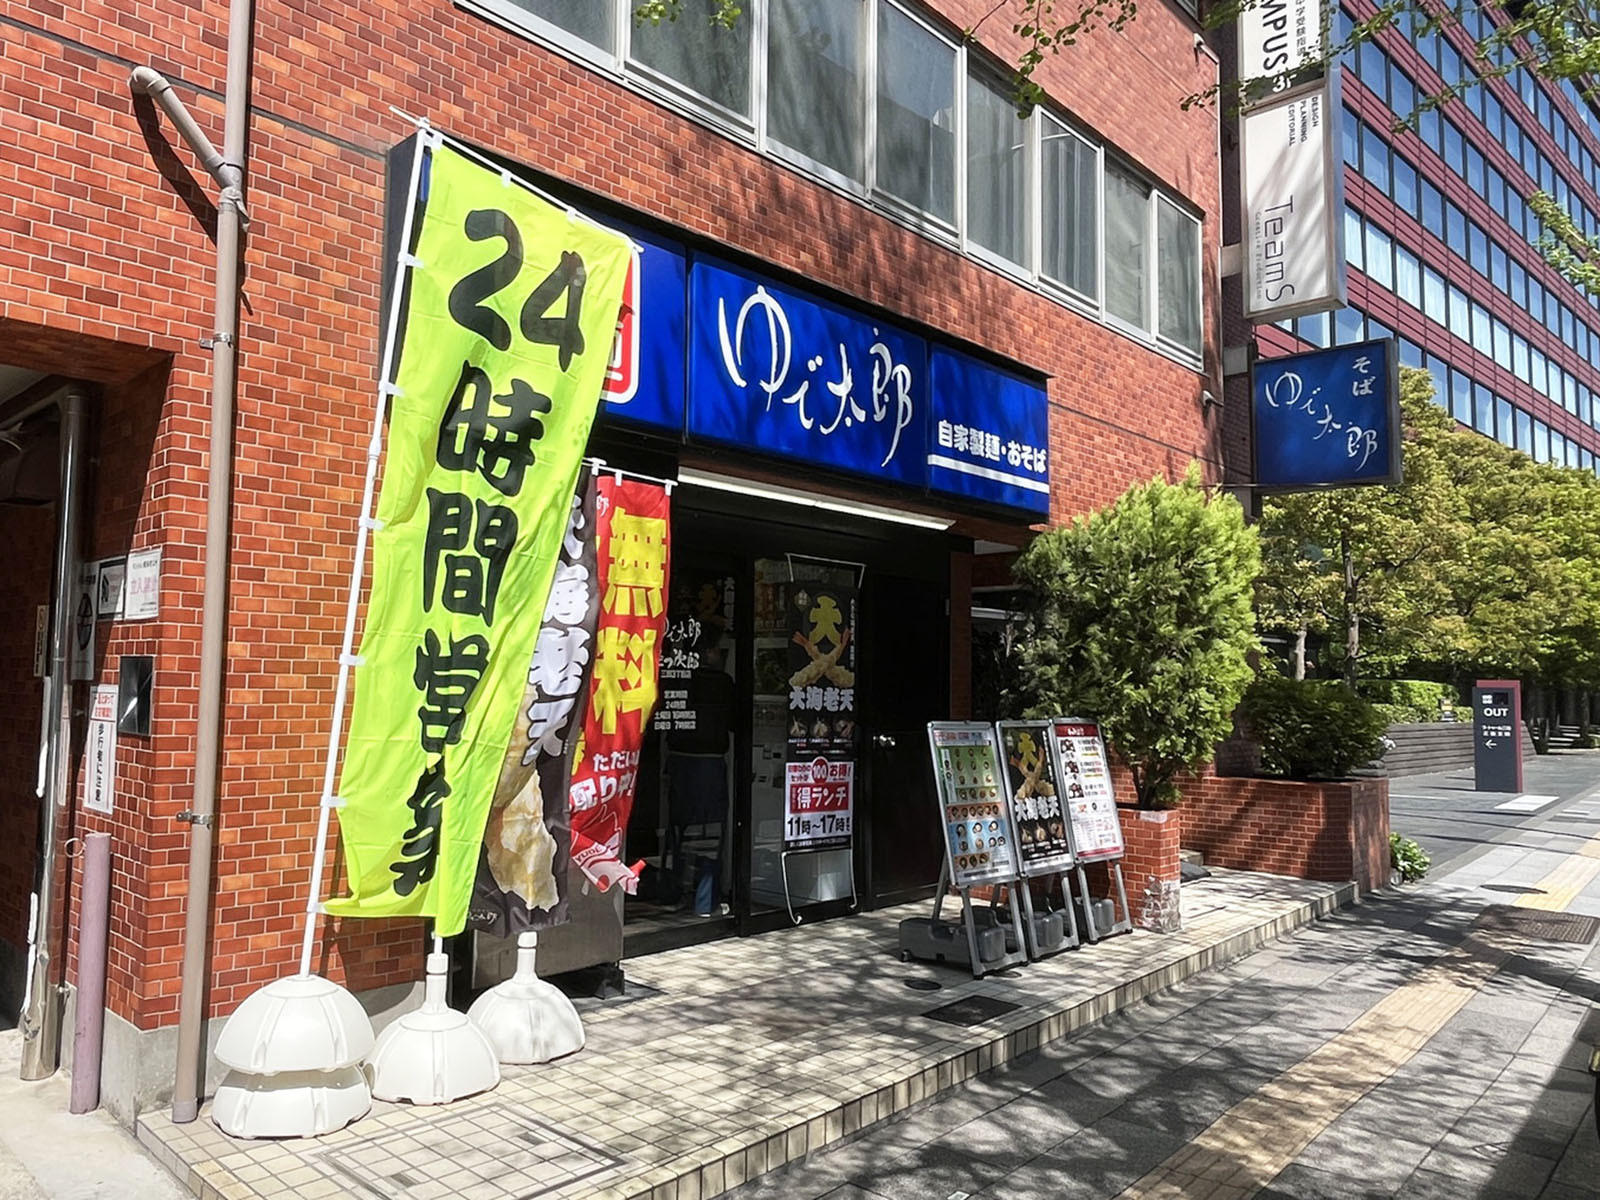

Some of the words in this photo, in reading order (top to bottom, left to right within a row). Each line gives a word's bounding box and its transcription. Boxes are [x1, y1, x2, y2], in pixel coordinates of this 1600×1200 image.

[1288, 104, 1296, 147] EDITORIAL
[1300, 100, 1308, 143] PLANNING
[1311, 96, 1319, 128] DESIGN
[718, 284, 913, 468] ゆで太郎
[1352, 355, 1377, 397] そば
[1265, 371, 1378, 472] ゆで太郎
[938, 418, 1048, 474] 自家製麺・おそば
[593, 506, 668, 735] 無料
[1483, 707, 1509, 717] OUT
[797, 786, 847, 810] 得ランチ
